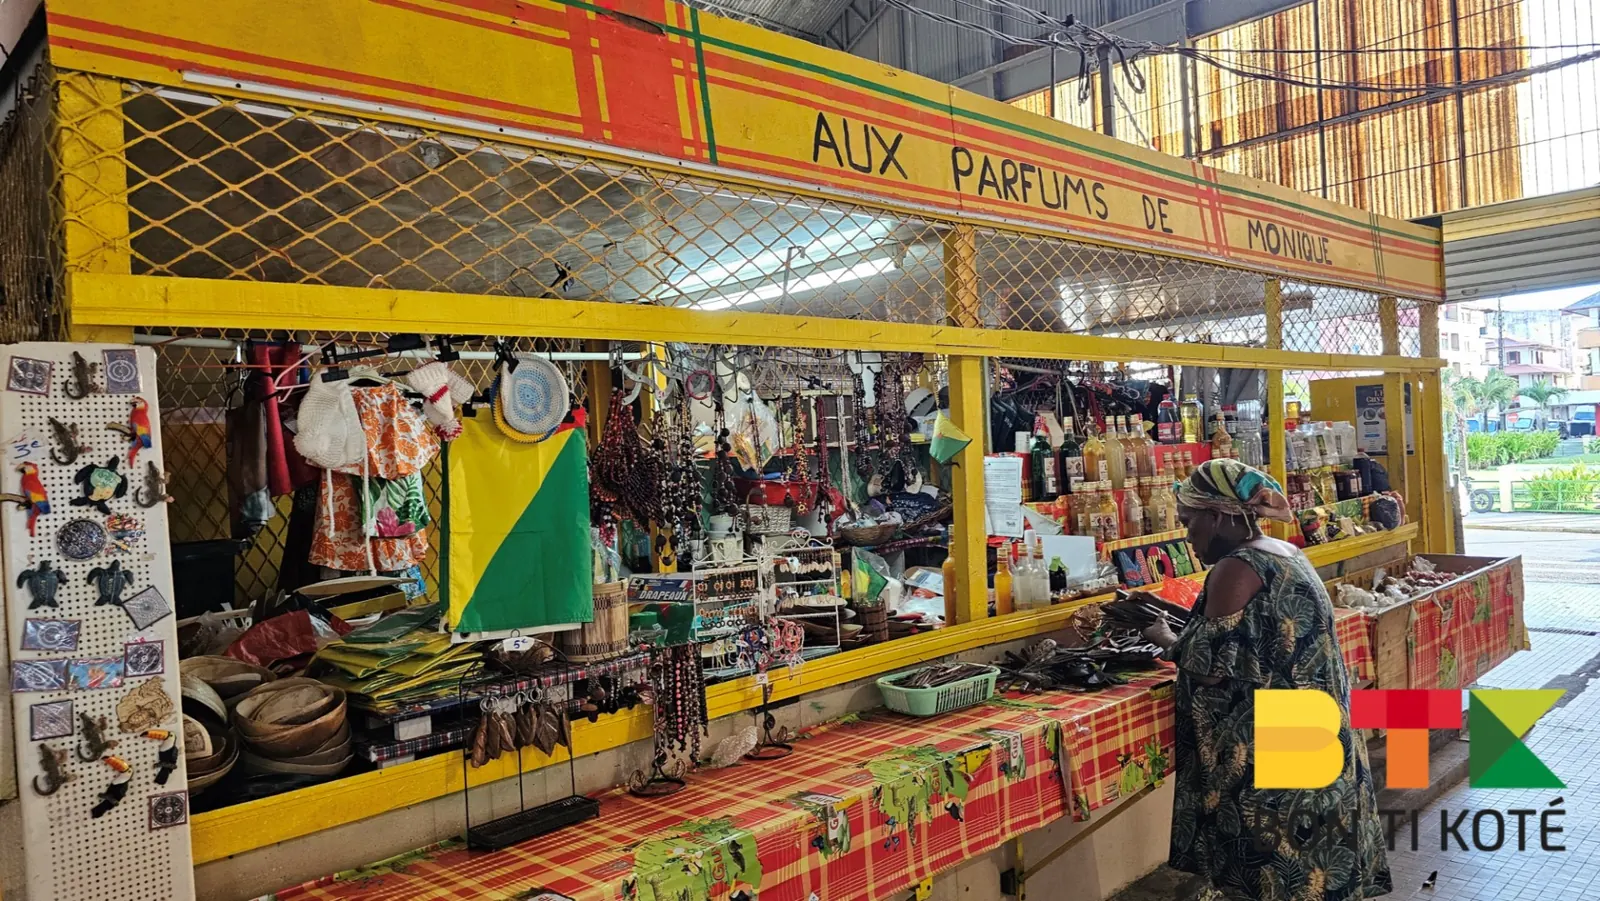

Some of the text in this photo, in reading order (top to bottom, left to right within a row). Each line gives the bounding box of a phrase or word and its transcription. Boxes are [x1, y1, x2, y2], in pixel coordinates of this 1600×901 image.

[813, 111, 1335, 266] AUX PARFUMS DE MONIQUE
[638, 590, 689, 601] DRAPEAUX
